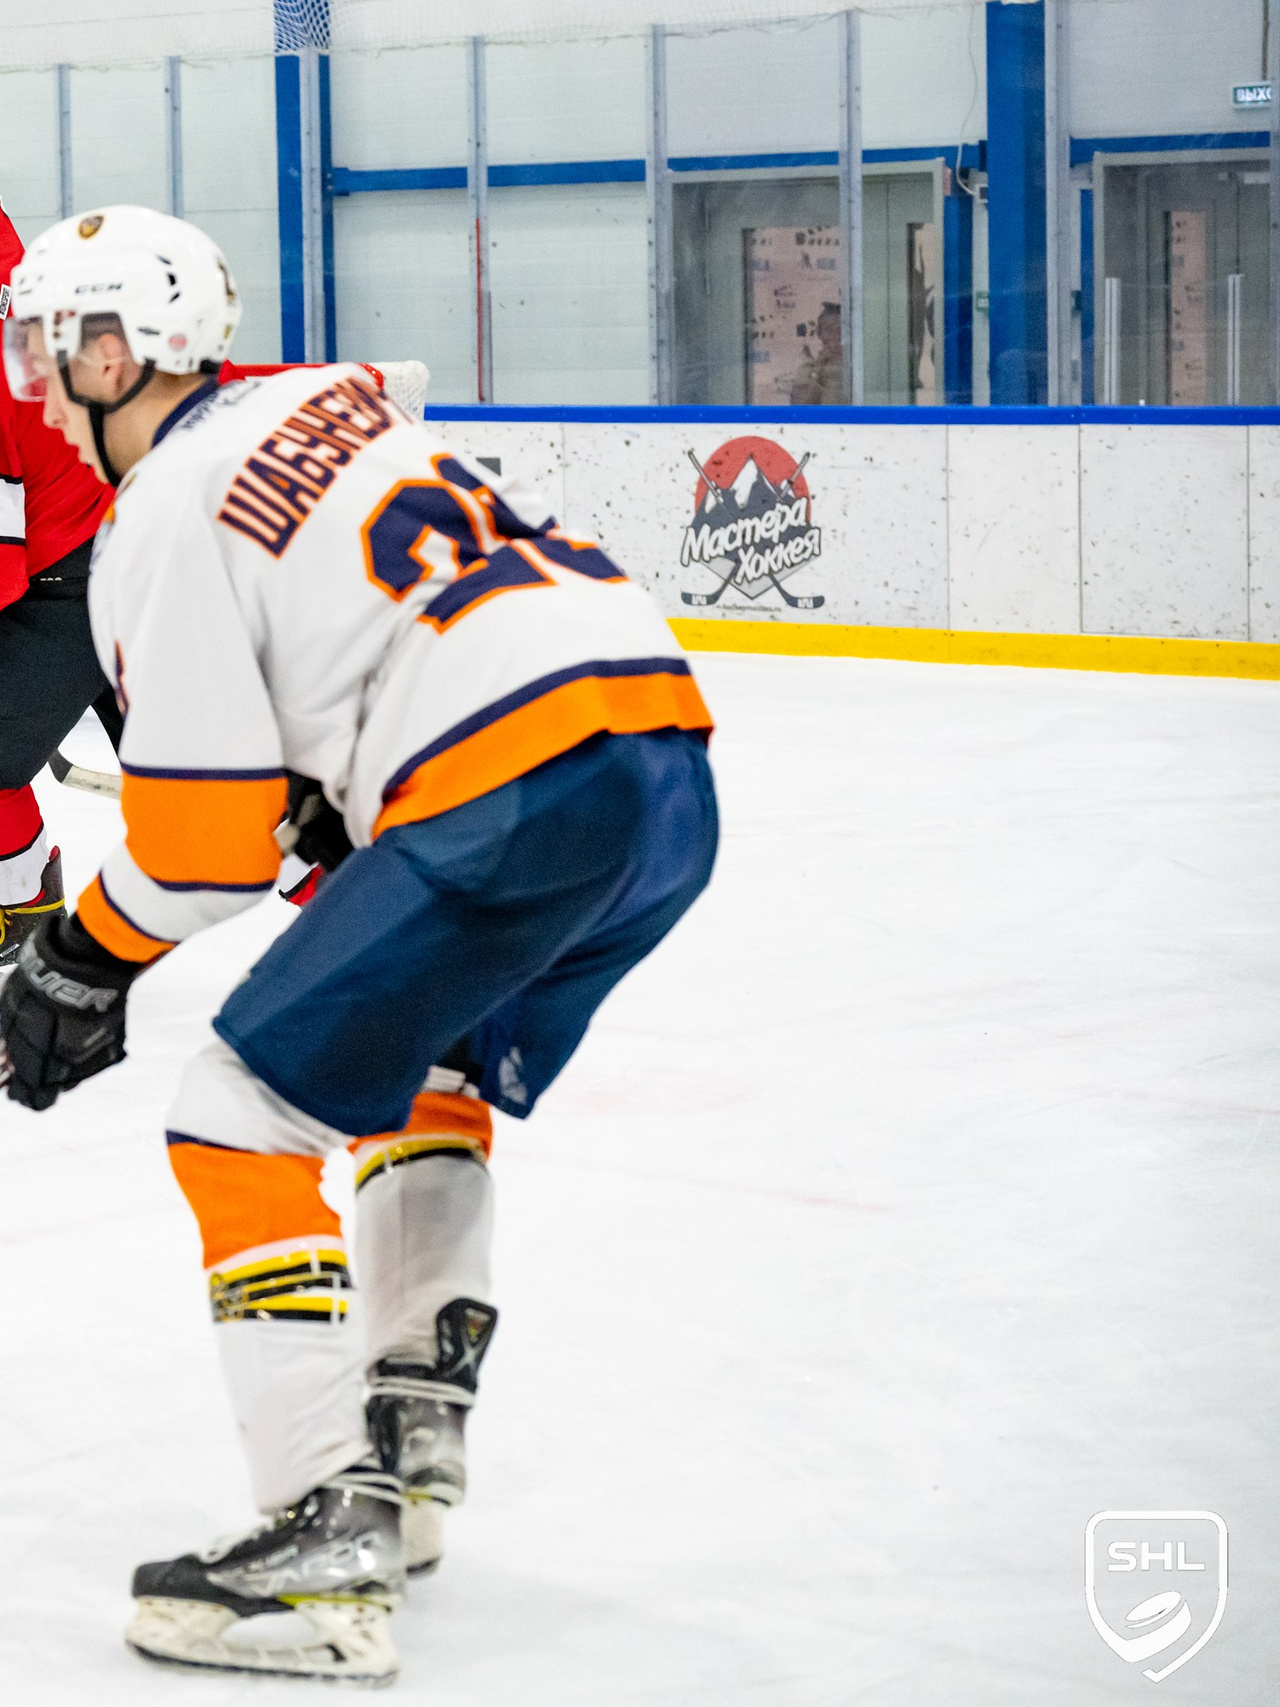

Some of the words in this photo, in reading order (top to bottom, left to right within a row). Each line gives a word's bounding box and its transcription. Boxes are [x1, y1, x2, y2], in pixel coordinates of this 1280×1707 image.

[75, 282, 123, 294] CCM
[681, 497, 808, 567] Мастера
[734, 528, 821, 585] Хоккея
